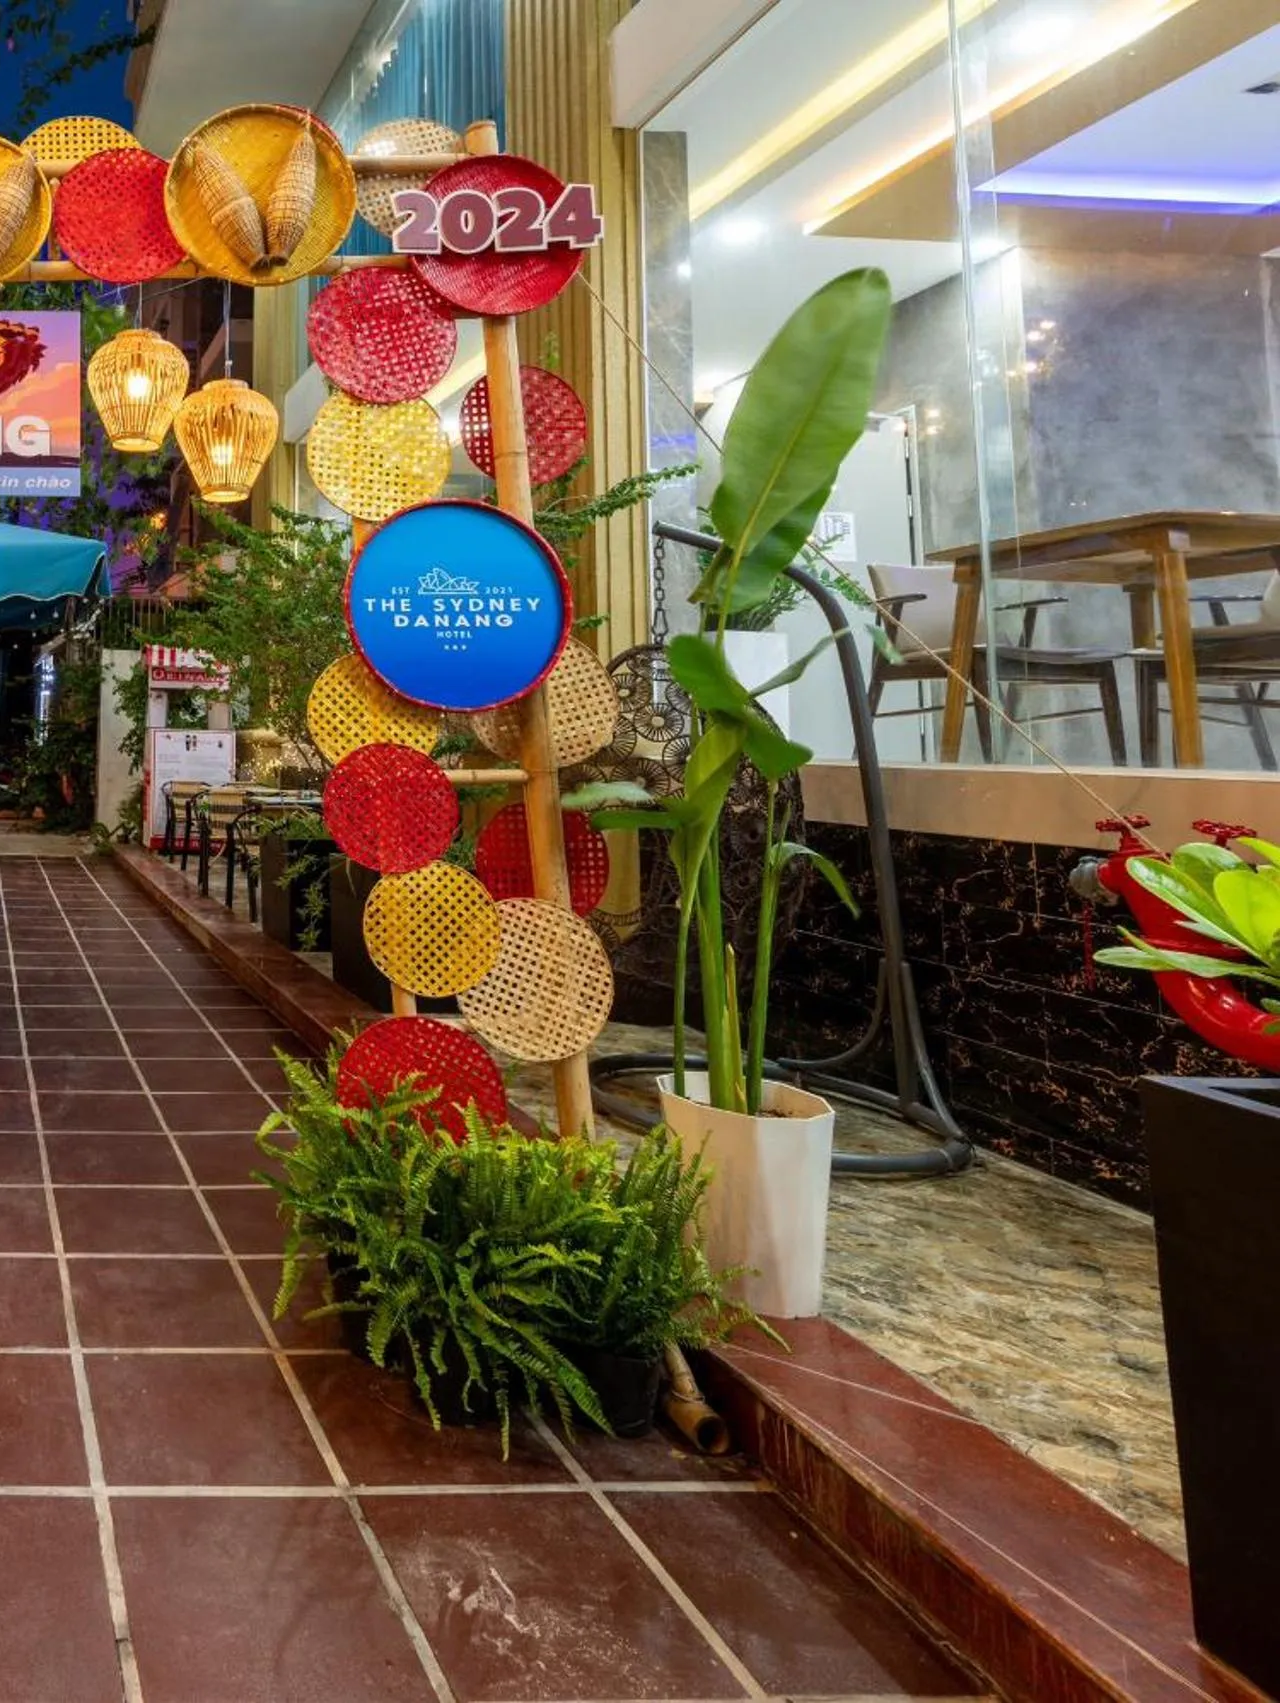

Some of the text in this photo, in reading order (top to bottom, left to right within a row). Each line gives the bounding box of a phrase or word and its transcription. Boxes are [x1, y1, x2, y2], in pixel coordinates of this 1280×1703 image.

[390, 183, 605, 255] 2024
[363, 598, 541, 613] THE SYDNEY
[393, 614, 514, 628] DANANG
[436, 630, 473, 639] HOTEL
